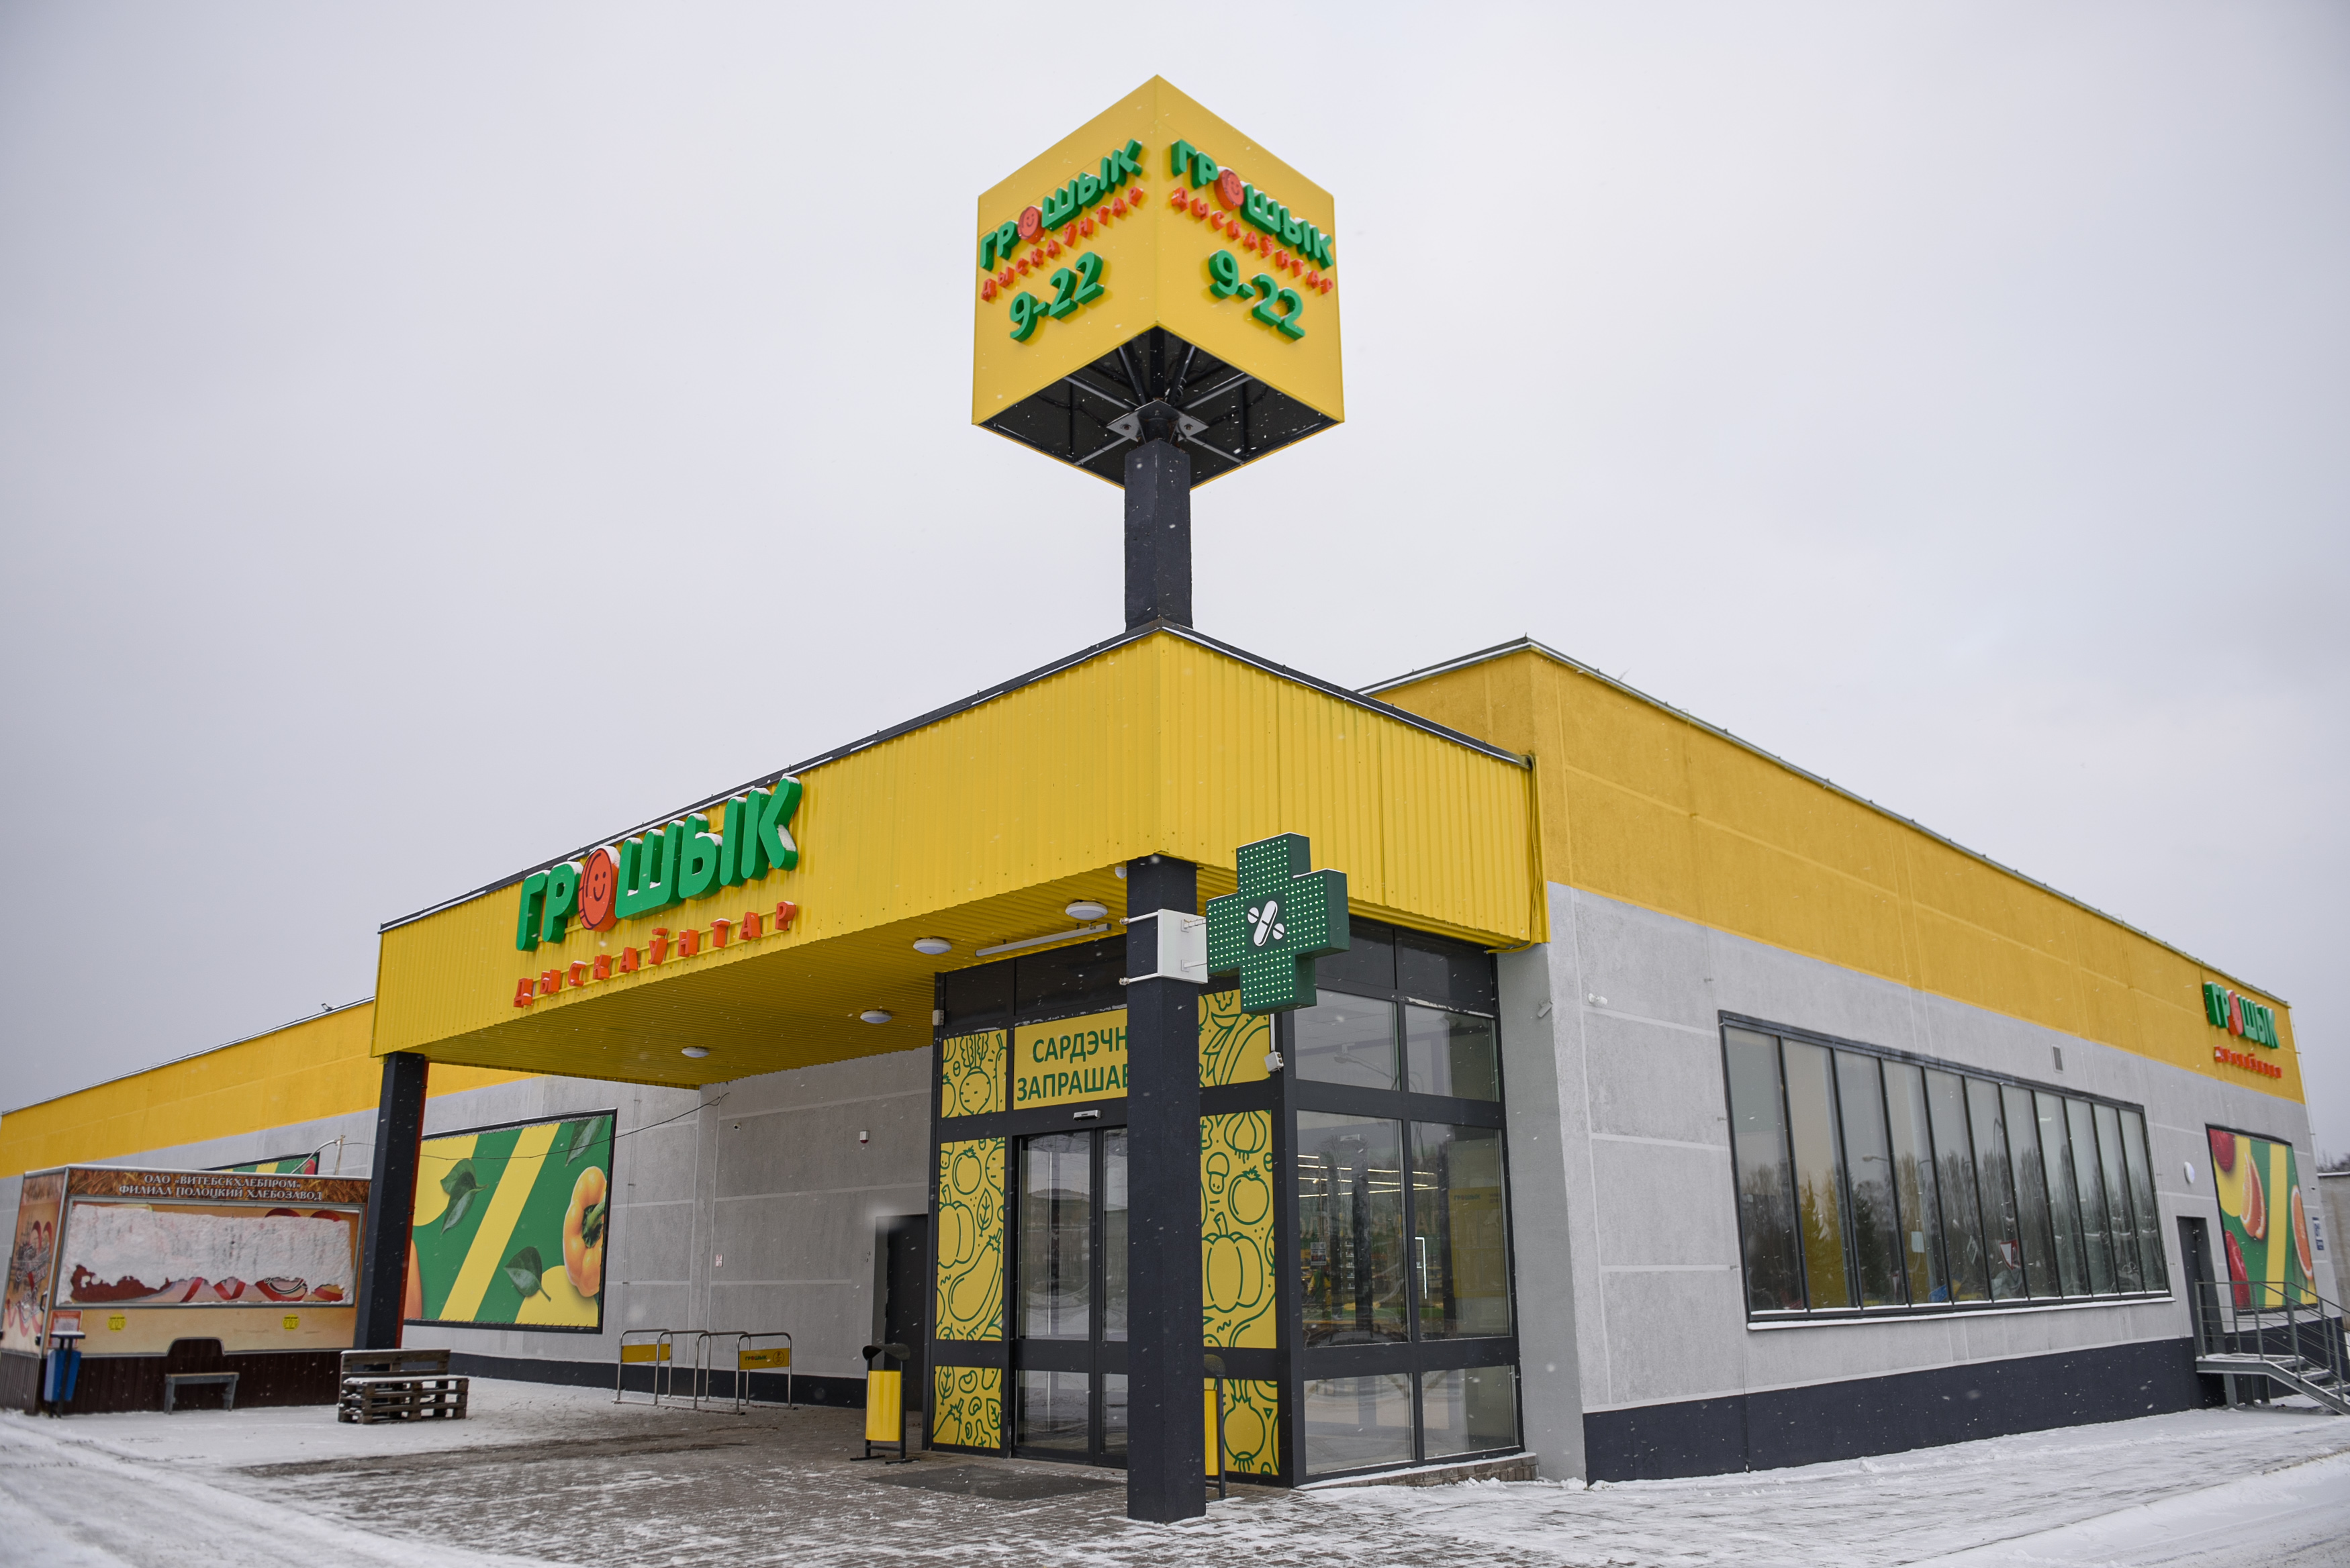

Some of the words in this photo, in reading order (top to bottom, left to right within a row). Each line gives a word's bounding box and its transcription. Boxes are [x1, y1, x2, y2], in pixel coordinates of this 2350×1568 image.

[980, 138, 1143, 272] ГРОШЫК
[981, 186, 1143, 302] ДЫСКАЎНТАР
[1171, 138, 1334, 270] ГРОШЫК
[1171, 187, 1333, 294] ДЫСКАЎНТАР
[1009, 251, 1104, 342] 9-22
[1209, 249, 1305, 340] 9-22
[516, 775, 802, 951] ГРОШЫК
[513, 901, 797, 1008] ДЫСКАЎНТАР
[1017, 1063, 1128, 1101] ЗАПРАШАЕ
[1032, 1025, 1128, 1064] САРДЭЧН
[119, 1185, 172, 1195] ФИЛИАЛ
[175, 1187, 243, 1198] ПОЛОЦКИЙ
[246, 1189, 322, 1202] ХЛЕБОЗАВОД
[143, 1175, 171, 1184] ОАО
